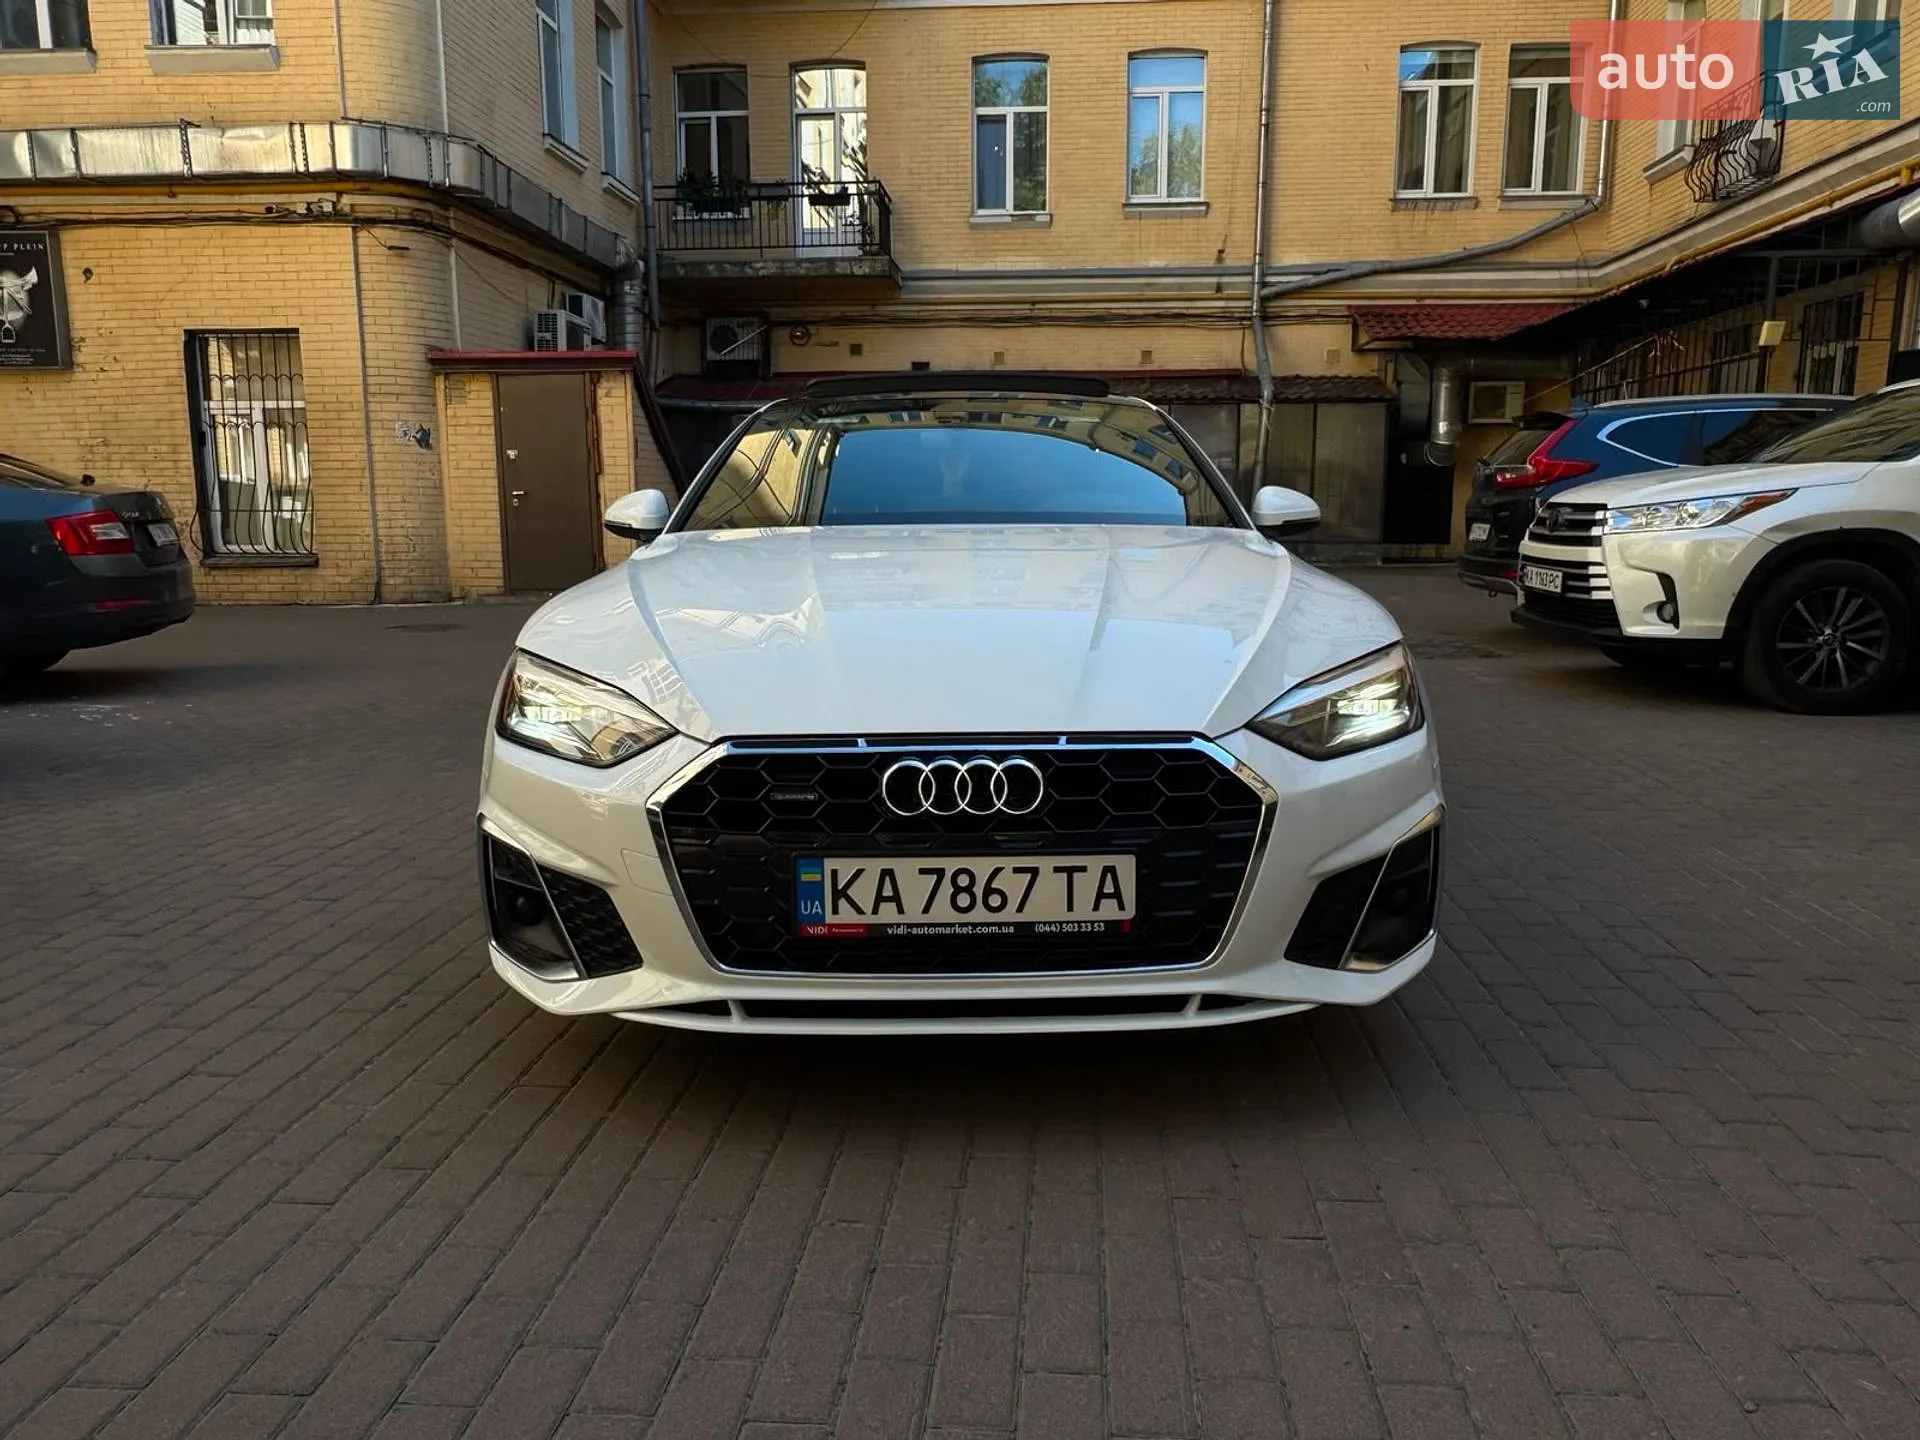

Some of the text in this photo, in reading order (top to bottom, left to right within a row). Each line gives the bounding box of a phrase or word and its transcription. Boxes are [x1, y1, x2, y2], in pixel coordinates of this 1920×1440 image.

[831, 864, 1126, 915] KA 7867 TA
[801, 901, 823, 916] UA
[887, 924, 1015, 935] vidi-automarket.com.ua
[1035, 922, 1105, 933] (044) 503 33 53
